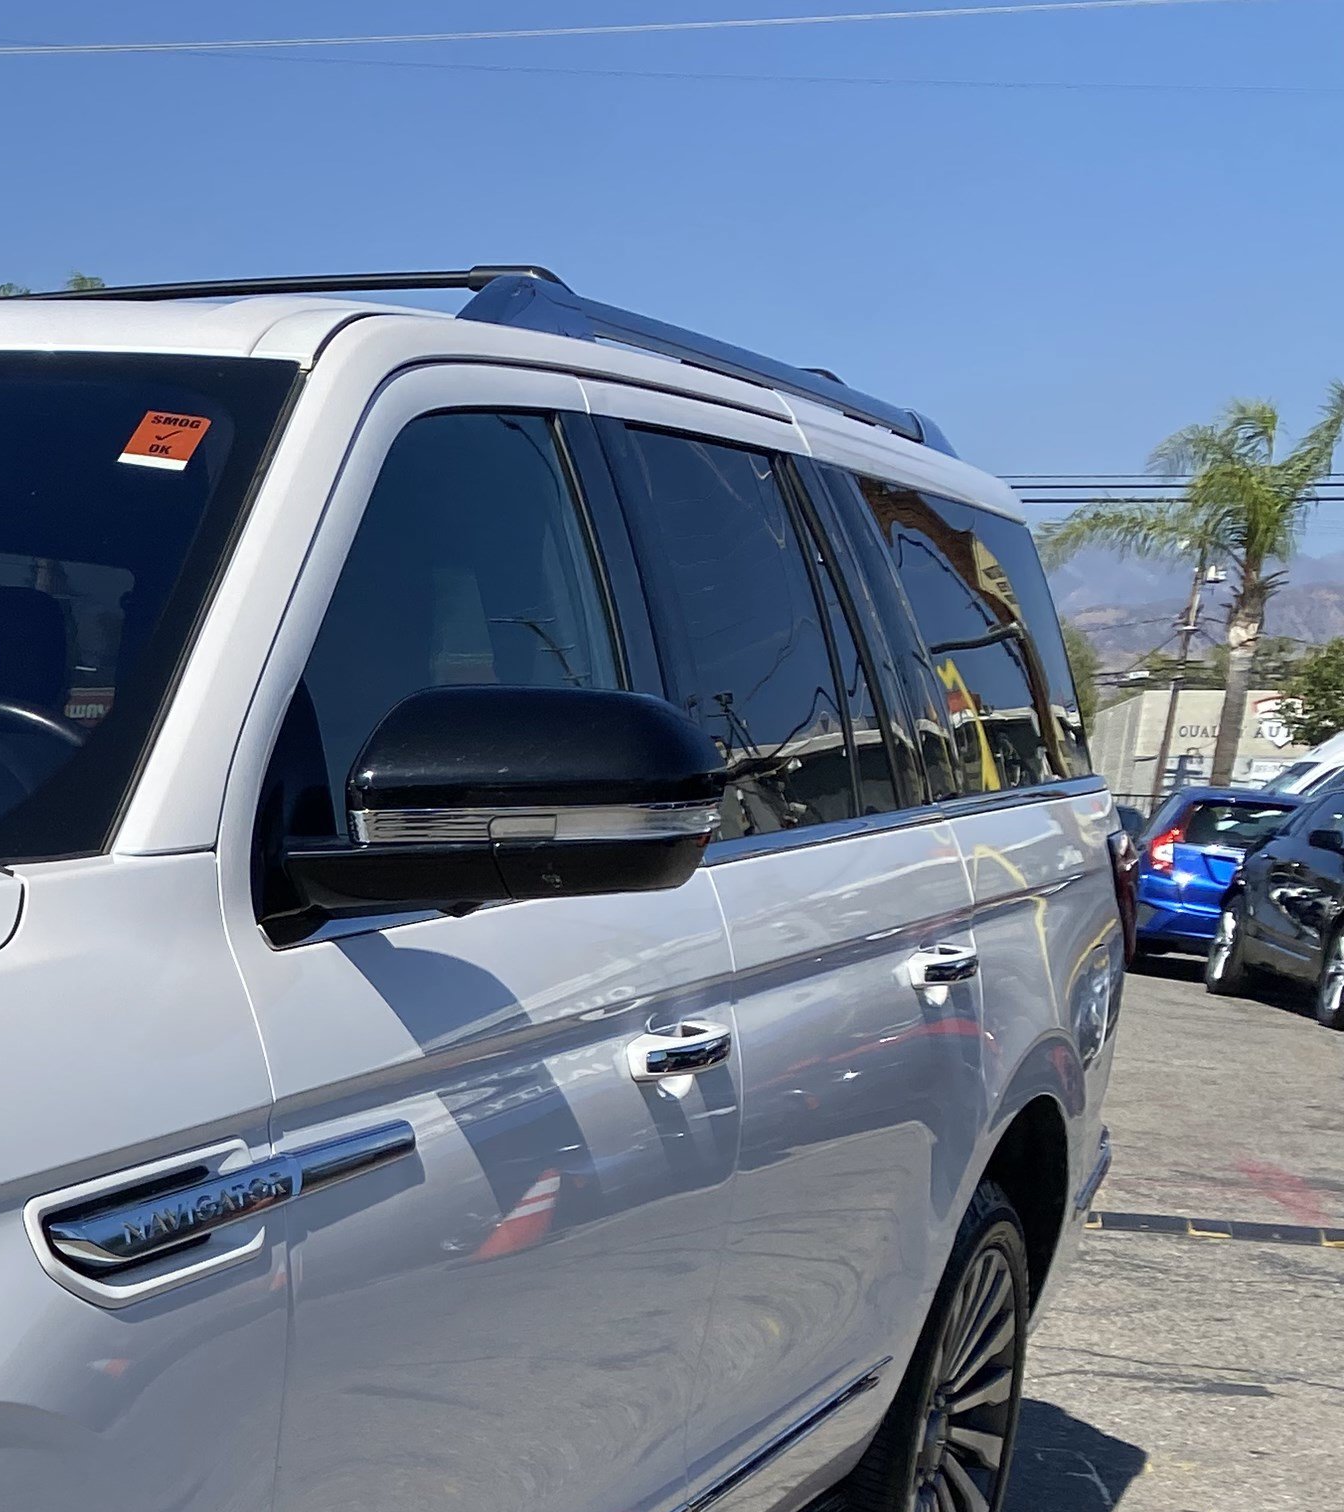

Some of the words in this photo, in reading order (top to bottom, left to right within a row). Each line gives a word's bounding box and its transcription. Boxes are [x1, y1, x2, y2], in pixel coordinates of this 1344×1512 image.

[151, 415, 202, 429] SMOG
[149, 444, 172, 455] OK
[123, 1171, 289, 1246] NAVIGATOR
